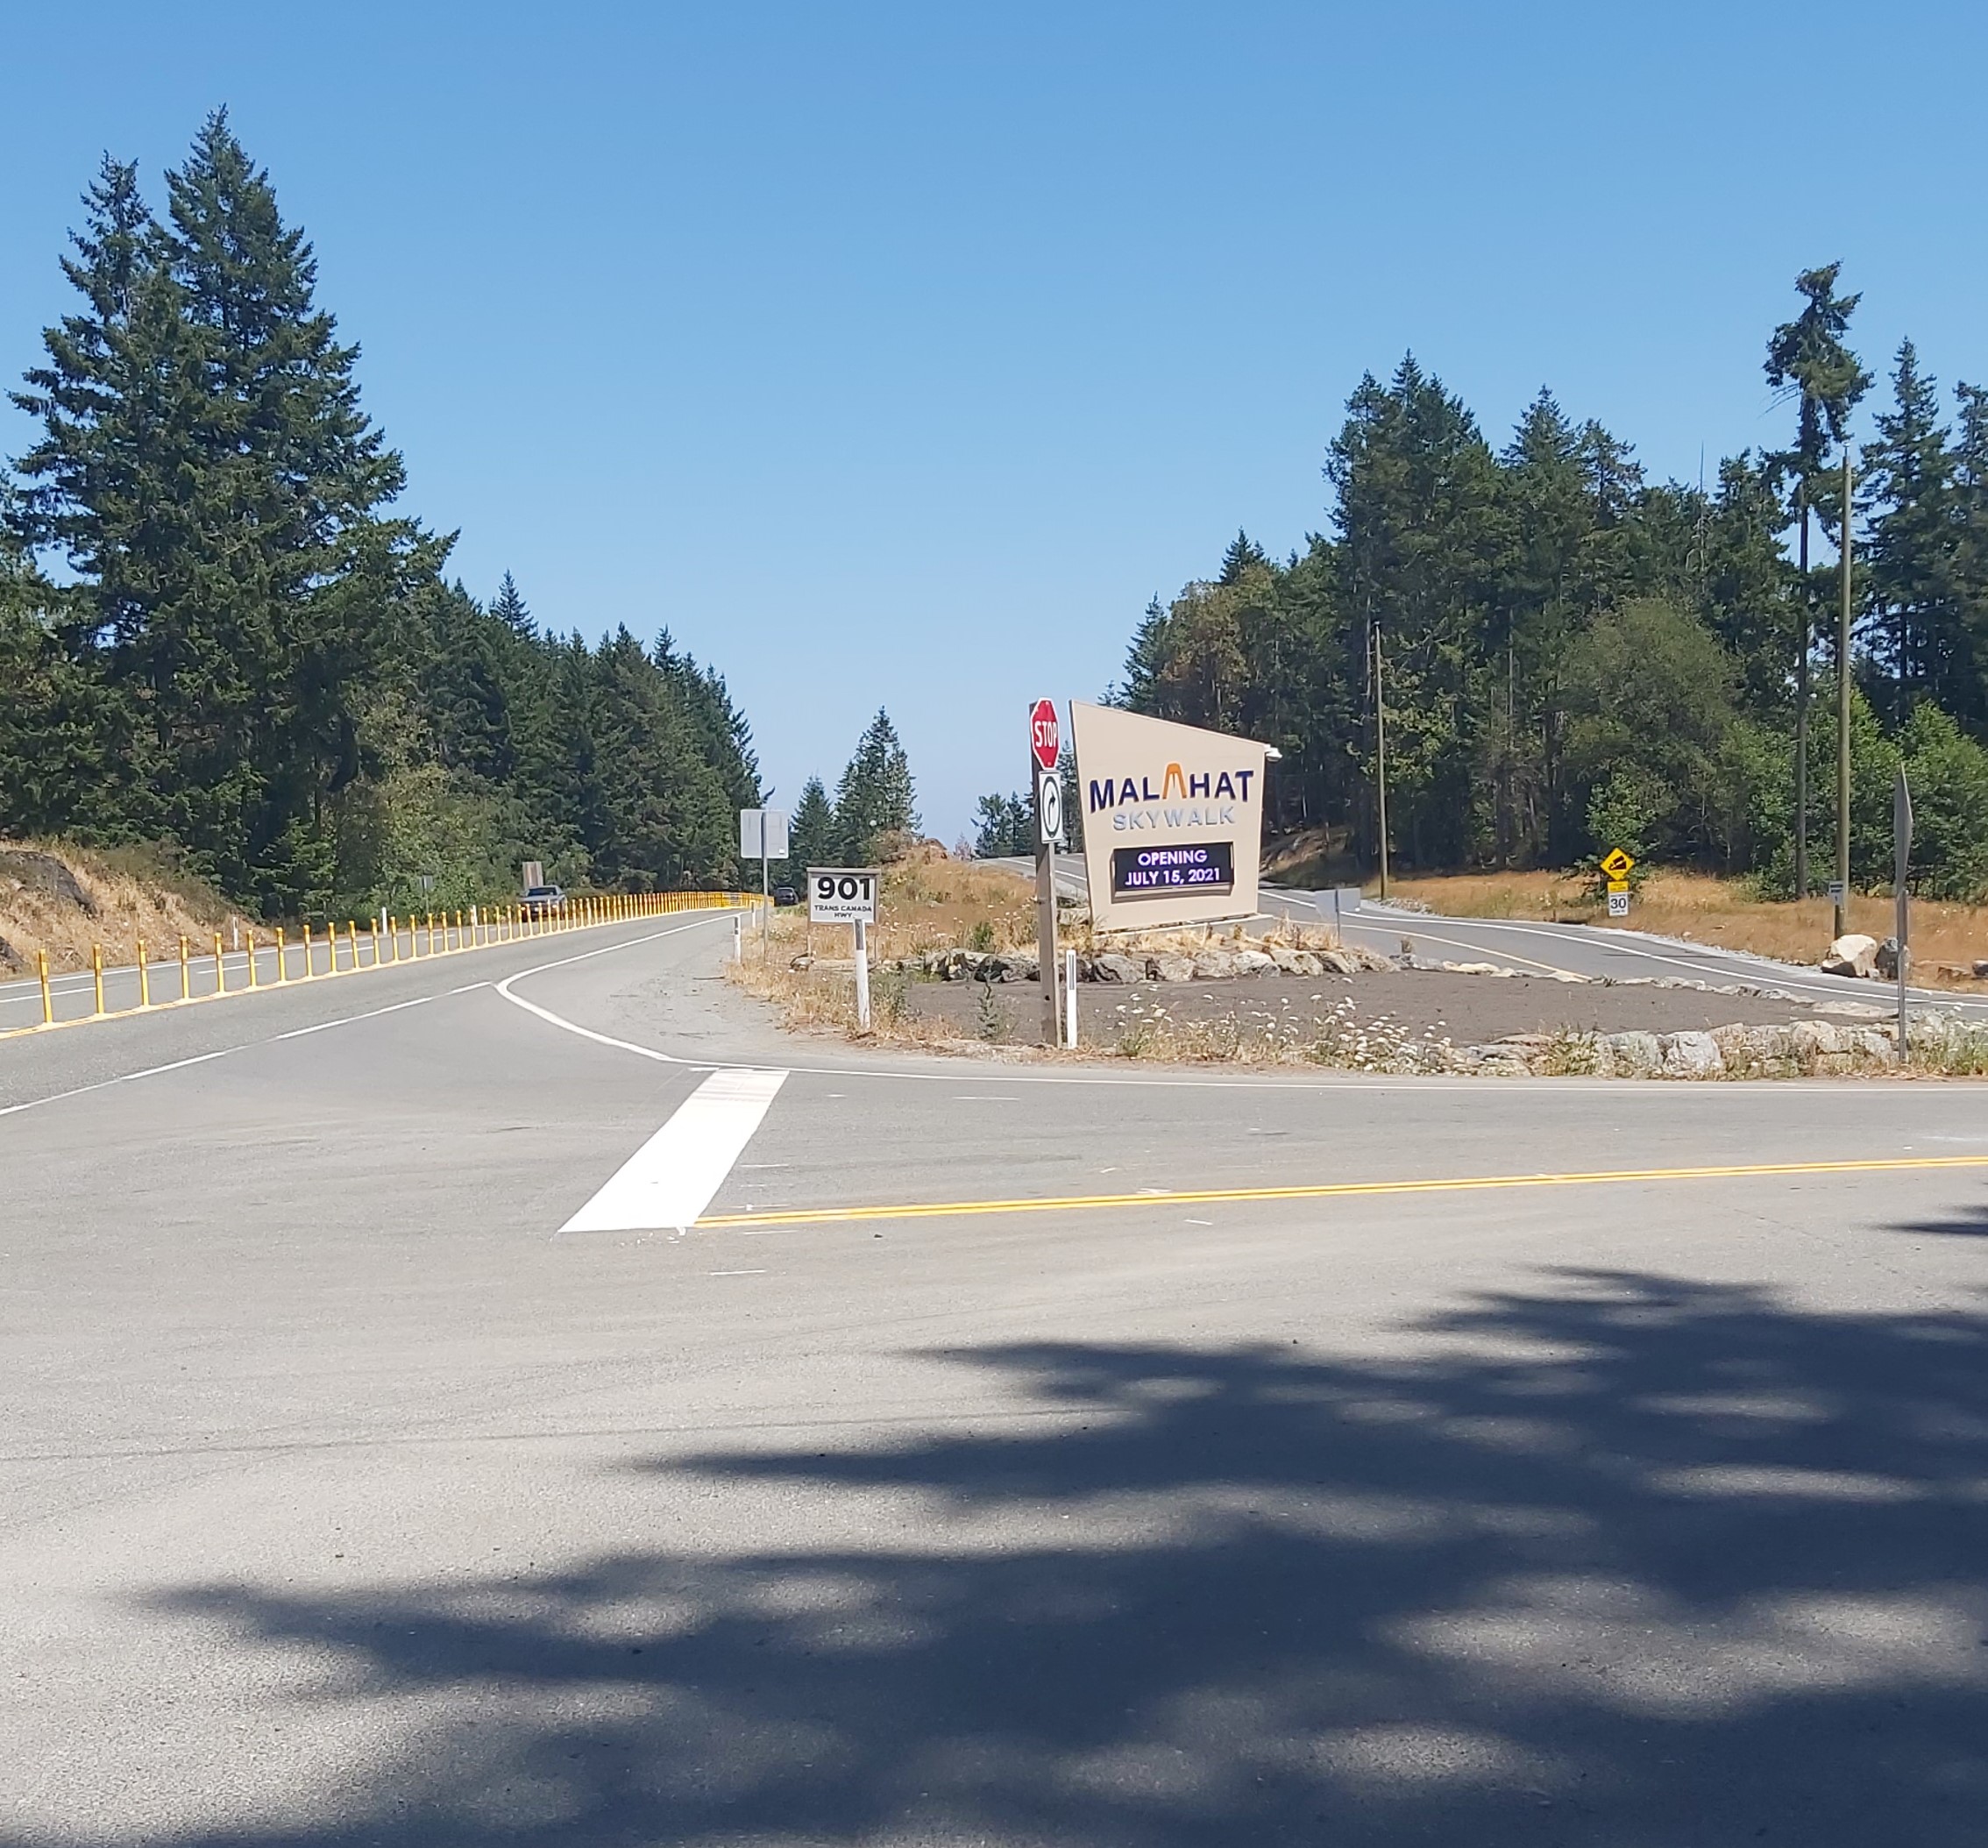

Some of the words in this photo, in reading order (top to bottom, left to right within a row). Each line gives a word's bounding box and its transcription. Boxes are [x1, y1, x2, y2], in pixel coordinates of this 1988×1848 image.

[1034, 721, 1058, 748] STOP
[1089, 762, 1254, 813] MALAHAT
[1113, 806, 1235, 831] SKYWALK
[1138, 849, 1207, 866] OPENING
[818, 877, 870, 900] 901
[1125, 871, 1159, 886] JULY
[1163, 870, 1184, 885] 15,
[1189, 868, 1220, 883] 2021
[1610, 898, 1627, 909] 30
